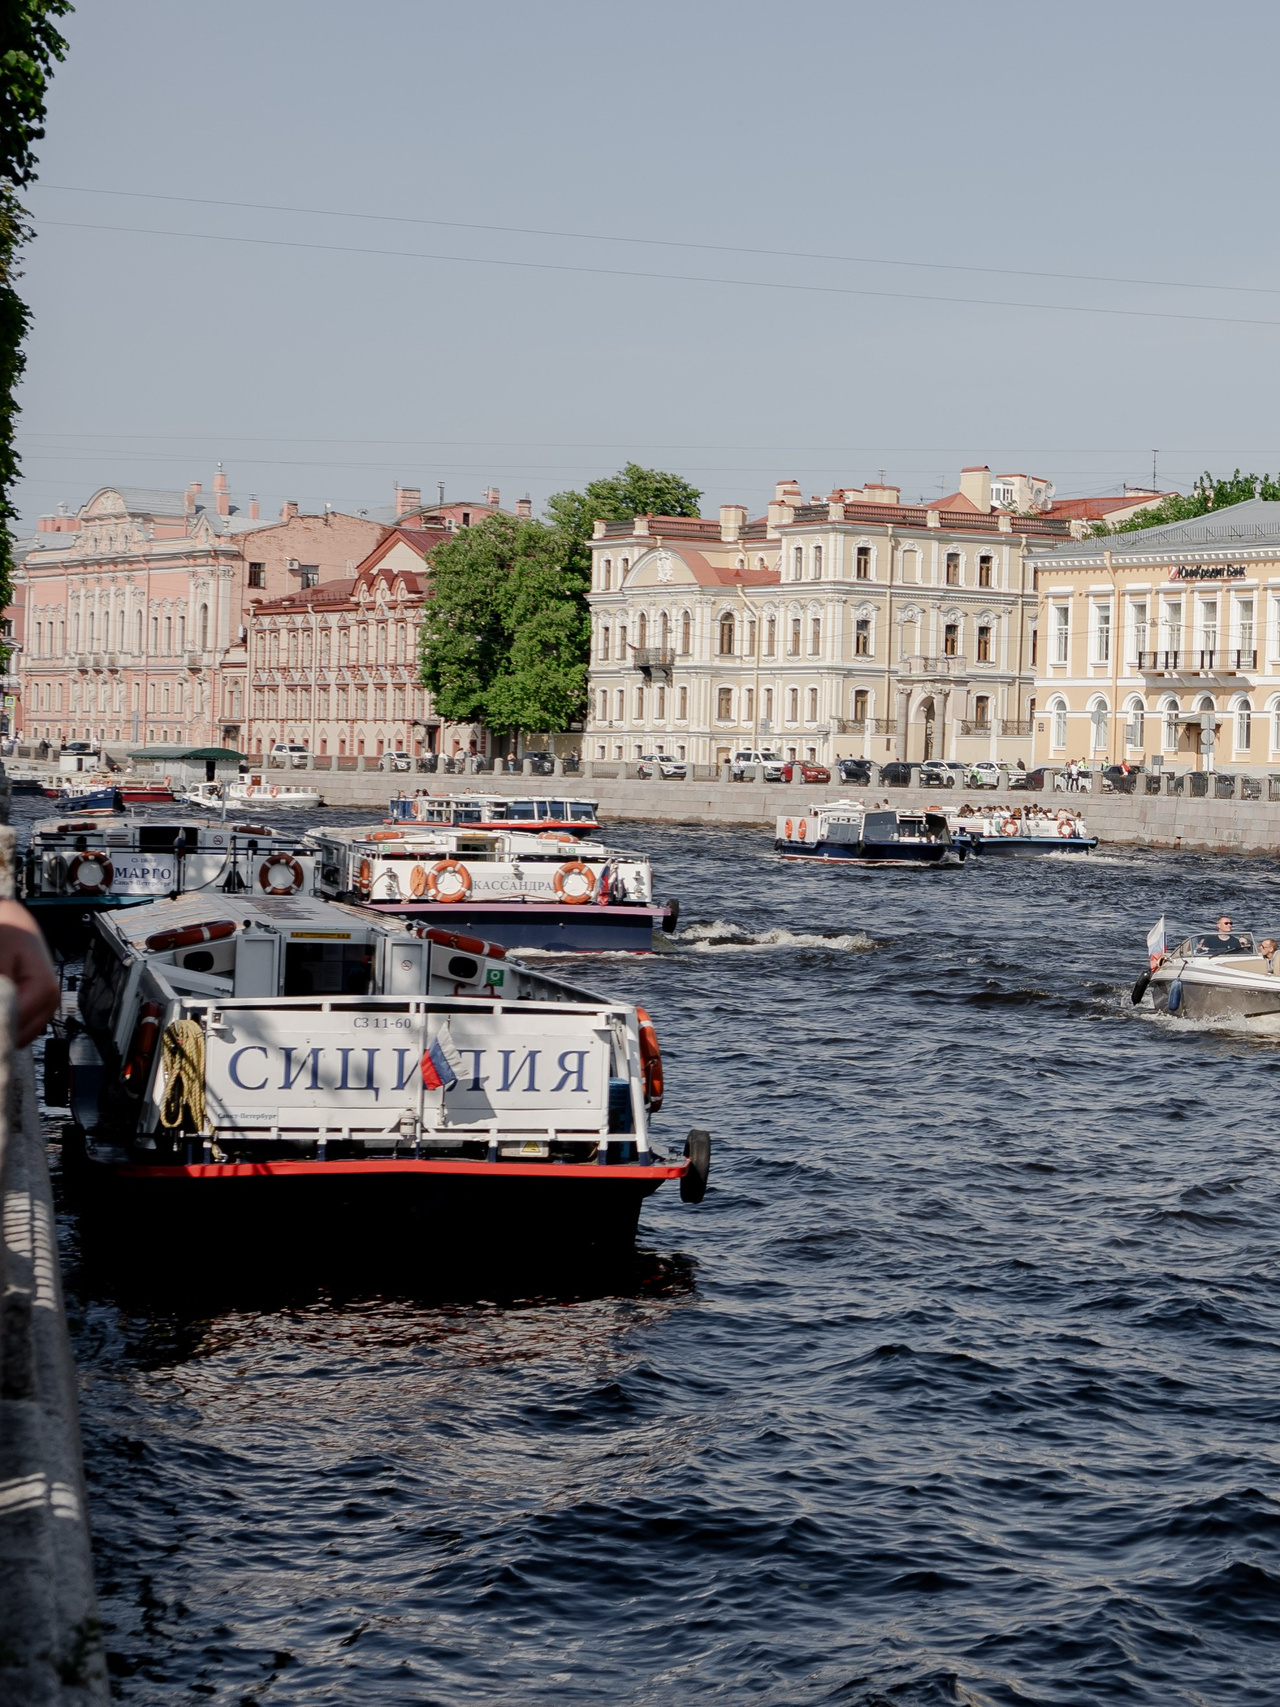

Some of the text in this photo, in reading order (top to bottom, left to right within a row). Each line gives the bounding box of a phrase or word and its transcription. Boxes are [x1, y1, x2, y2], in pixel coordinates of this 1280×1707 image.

[1178, 564, 1246, 580] ЮниКредит Банк
[114, 867, 172, 880] МАРГО
[473, 880, 555, 892] КАССАНДРА
[373, 1017, 412, 1029] 11-60
[217, 1112, 278, 1121] Санкт-Петербург
